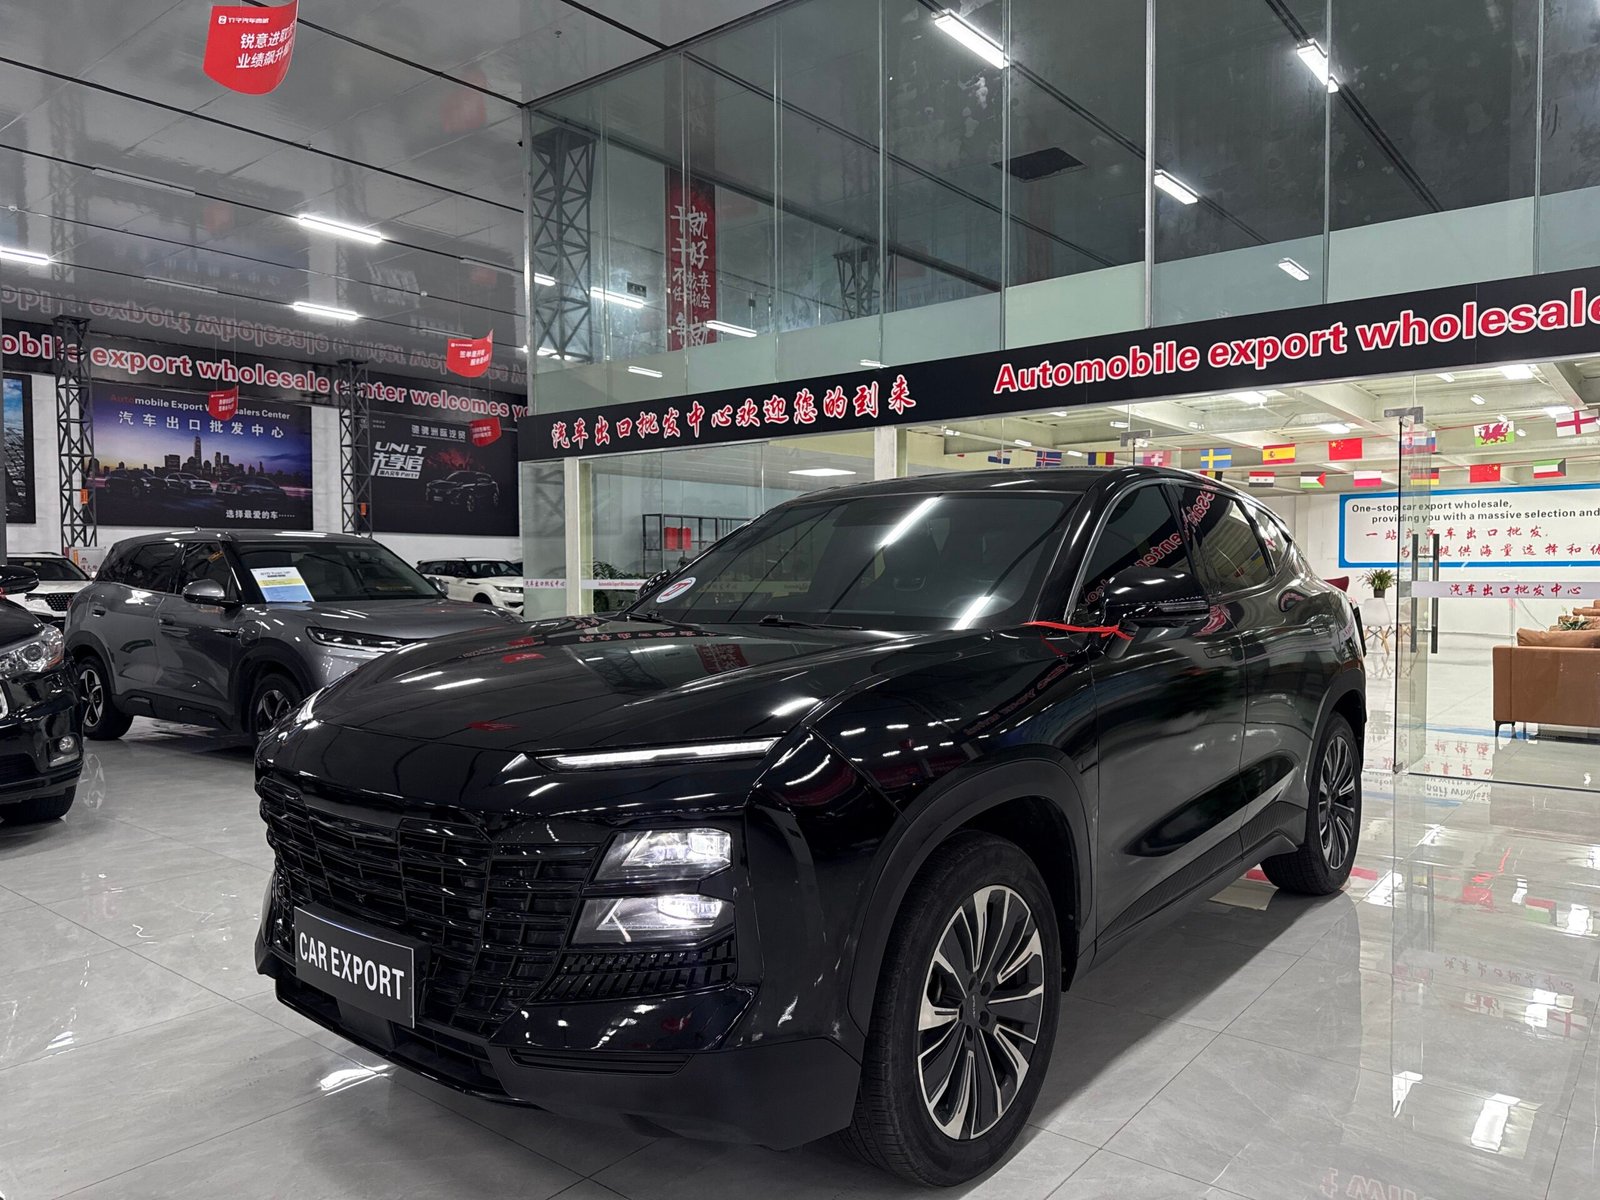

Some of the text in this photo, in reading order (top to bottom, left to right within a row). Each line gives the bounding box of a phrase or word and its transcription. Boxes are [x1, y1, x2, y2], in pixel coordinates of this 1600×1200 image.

[993, 341, 1200, 394] Automobile
[1208, 321, 1348, 371] export
[91, 347, 192, 376] export
[196, 359, 330, 393] wholesale
[410, 389, 509, 417] welcomes
[171, 401, 203, 412] Export
[262, 410, 290, 420] Center
[552, 374, 916, 449] 汽车出口批发中心欢迎您的到来
[118, 411, 284, 439] 汽车出口批发中心
[375, 441, 427, 455] UNI-T
[1352, 503, 1398, 514] One-stop
[1419, 502, 1452, 514] export
[1455, 499, 1512, 509] wholesale,
[1421, 514, 1440, 523] you
[1443, 512, 1466, 521] with
[1477, 510, 1522, 520] massive
[1524, 509, 1576, 518] selection
[1579, 508, 1600, 517] and
[1449, 583, 1582, 598] 汽车出口批发中心
[299, 931, 405, 1001] CAR EXPORT
